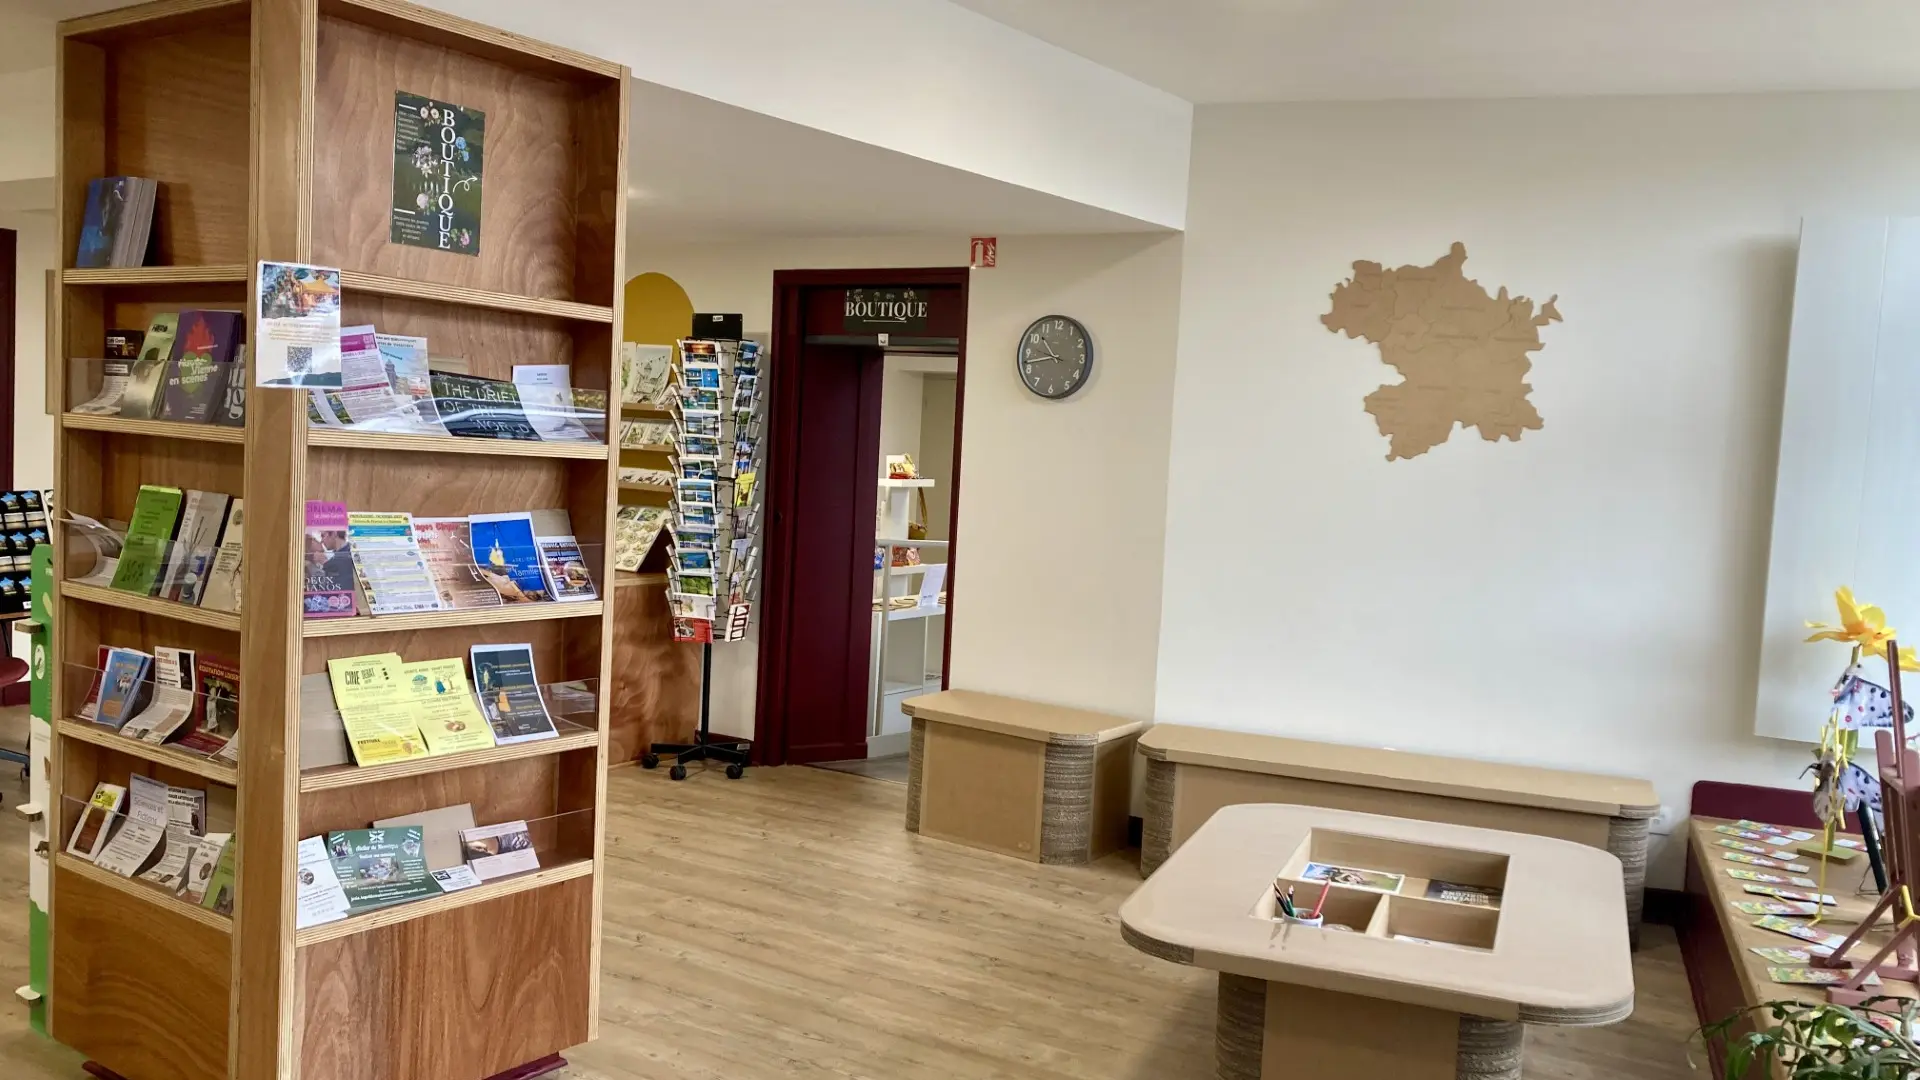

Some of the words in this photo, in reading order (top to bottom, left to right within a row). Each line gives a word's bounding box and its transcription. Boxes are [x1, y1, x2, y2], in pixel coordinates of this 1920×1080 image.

[438, 109, 456, 249] BOUTIQUE
[845, 301, 928, 320] BOUTIQUE
[1042, 323, 1049, 334] 11
[1054, 320, 1064, 330] 12
[1069, 326, 1074, 336] 1
[1030, 333, 1040, 344] 10
[1077, 338, 1084, 348] 2
[1025, 348, 1031, 358] 9
[1078, 354, 1085, 364] 3
[1026, 364, 1032, 374] 8
[1072, 369, 1080, 380] 4
[1034, 377, 1040, 387] 7
[1064, 380, 1070, 390] 5
[442, 382, 472, 400] THE
[476, 384, 518, 405] DRIFT
[1047, 384, 1054, 394] 6
[443, 400, 464, 413] OF
[304, 583, 342, 592] IANOS
